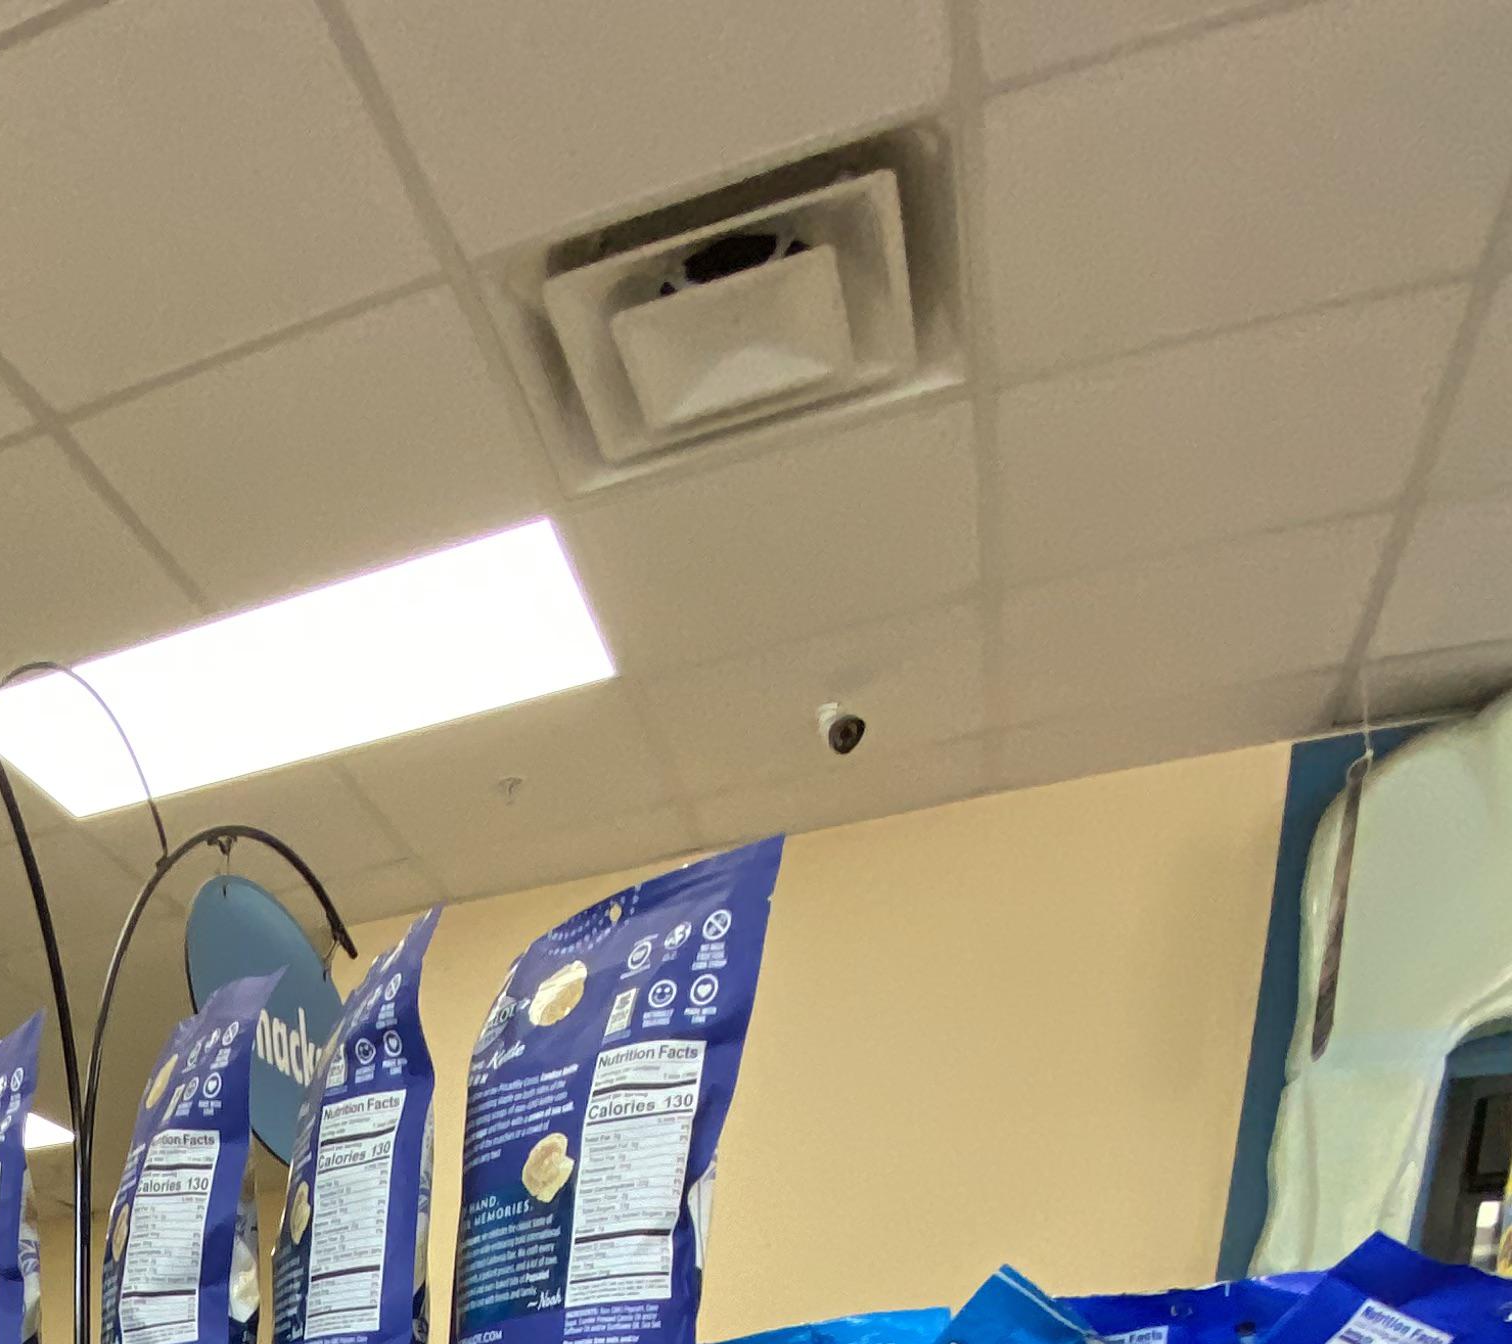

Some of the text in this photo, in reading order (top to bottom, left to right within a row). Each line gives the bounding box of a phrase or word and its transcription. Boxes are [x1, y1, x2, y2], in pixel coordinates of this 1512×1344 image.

[598, 1044, 699, 1070] Nutrition Facts
[324, 1094, 401, 1122] Nutrition Facts
[588, 1093, 693, 1120] Calories 130
[182, 1133, 216, 1148] Facts
[317, 1140, 392, 1169] Calories 130
[186, 1176, 209, 1191] 130
